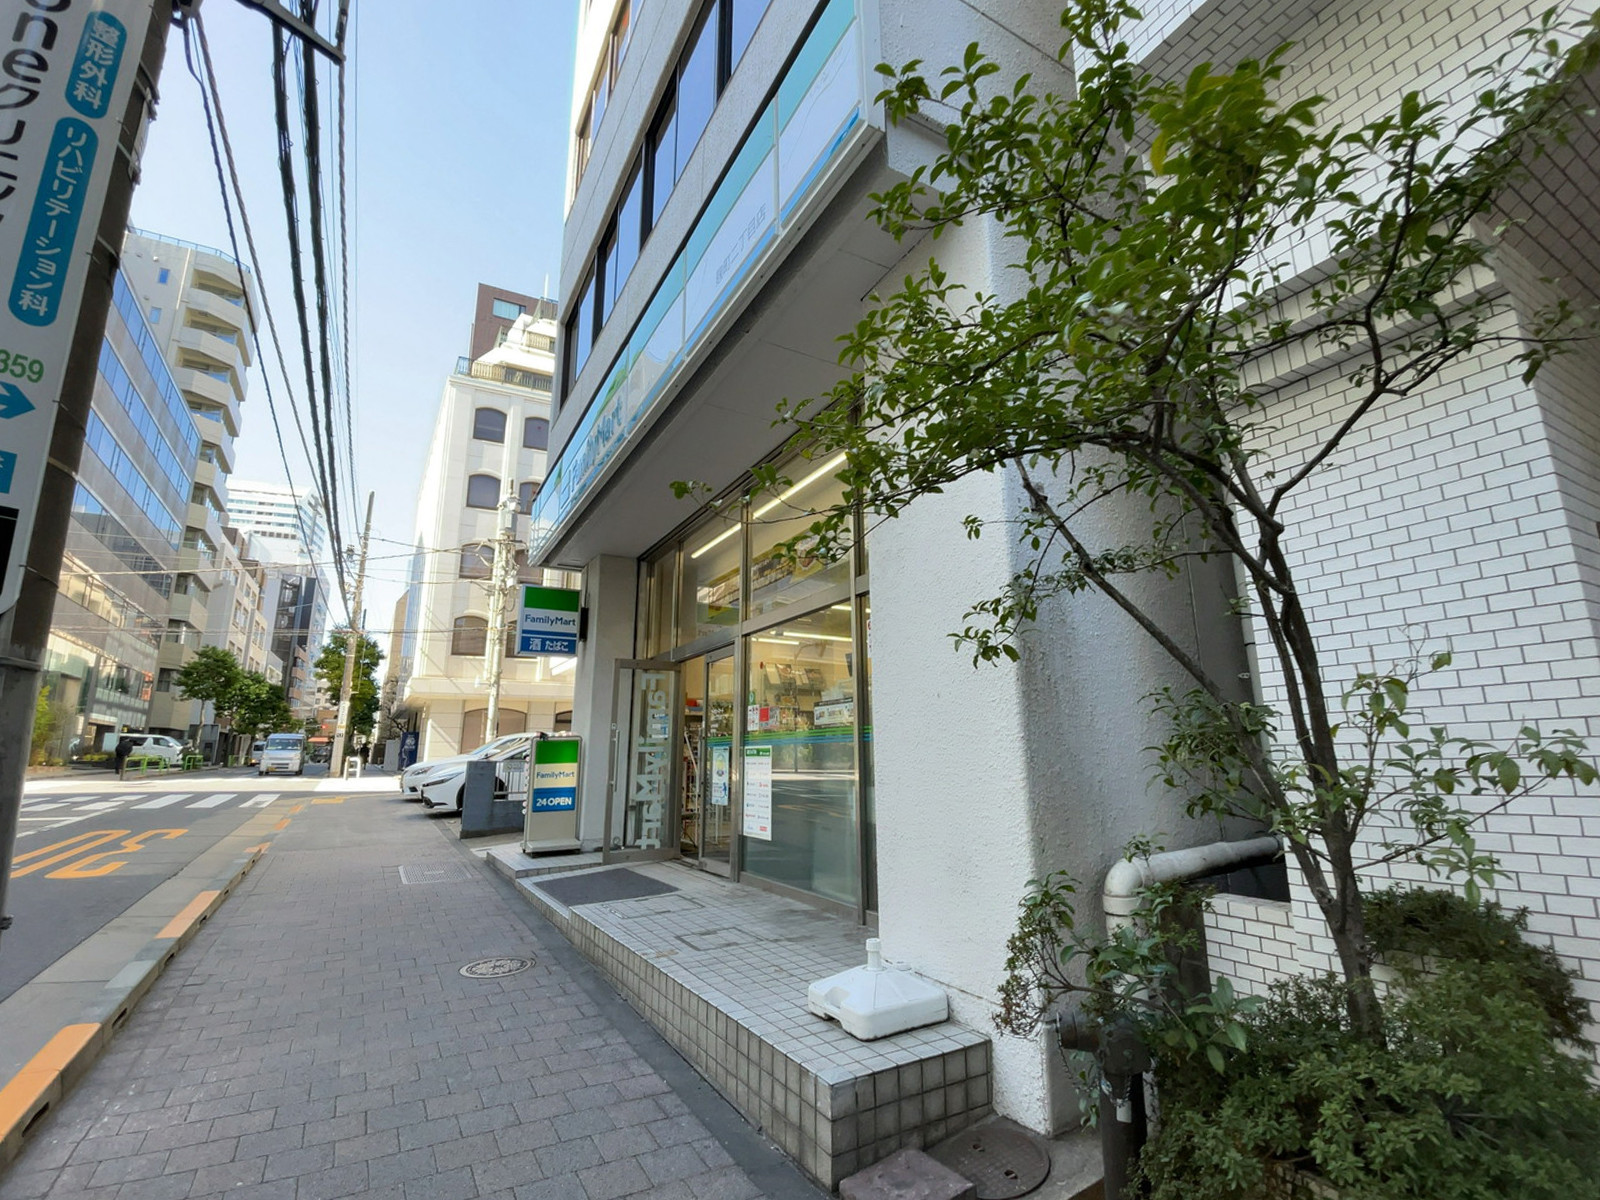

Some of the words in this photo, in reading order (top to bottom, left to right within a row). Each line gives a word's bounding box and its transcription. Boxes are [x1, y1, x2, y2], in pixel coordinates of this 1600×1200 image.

[73, 18, 120, 110] 整形外科
[18, 126, 87, 317] リハビリテーション科
[524, 613, 577, 626] FamilyMart
[528, 637, 542, 651] 酒
[544, 640, 569, 652] たばこ
[536, 771, 575, 779] FamilyMart
[536, 797, 547, 807] 24
[547, 796, 572, 806] OPEN
